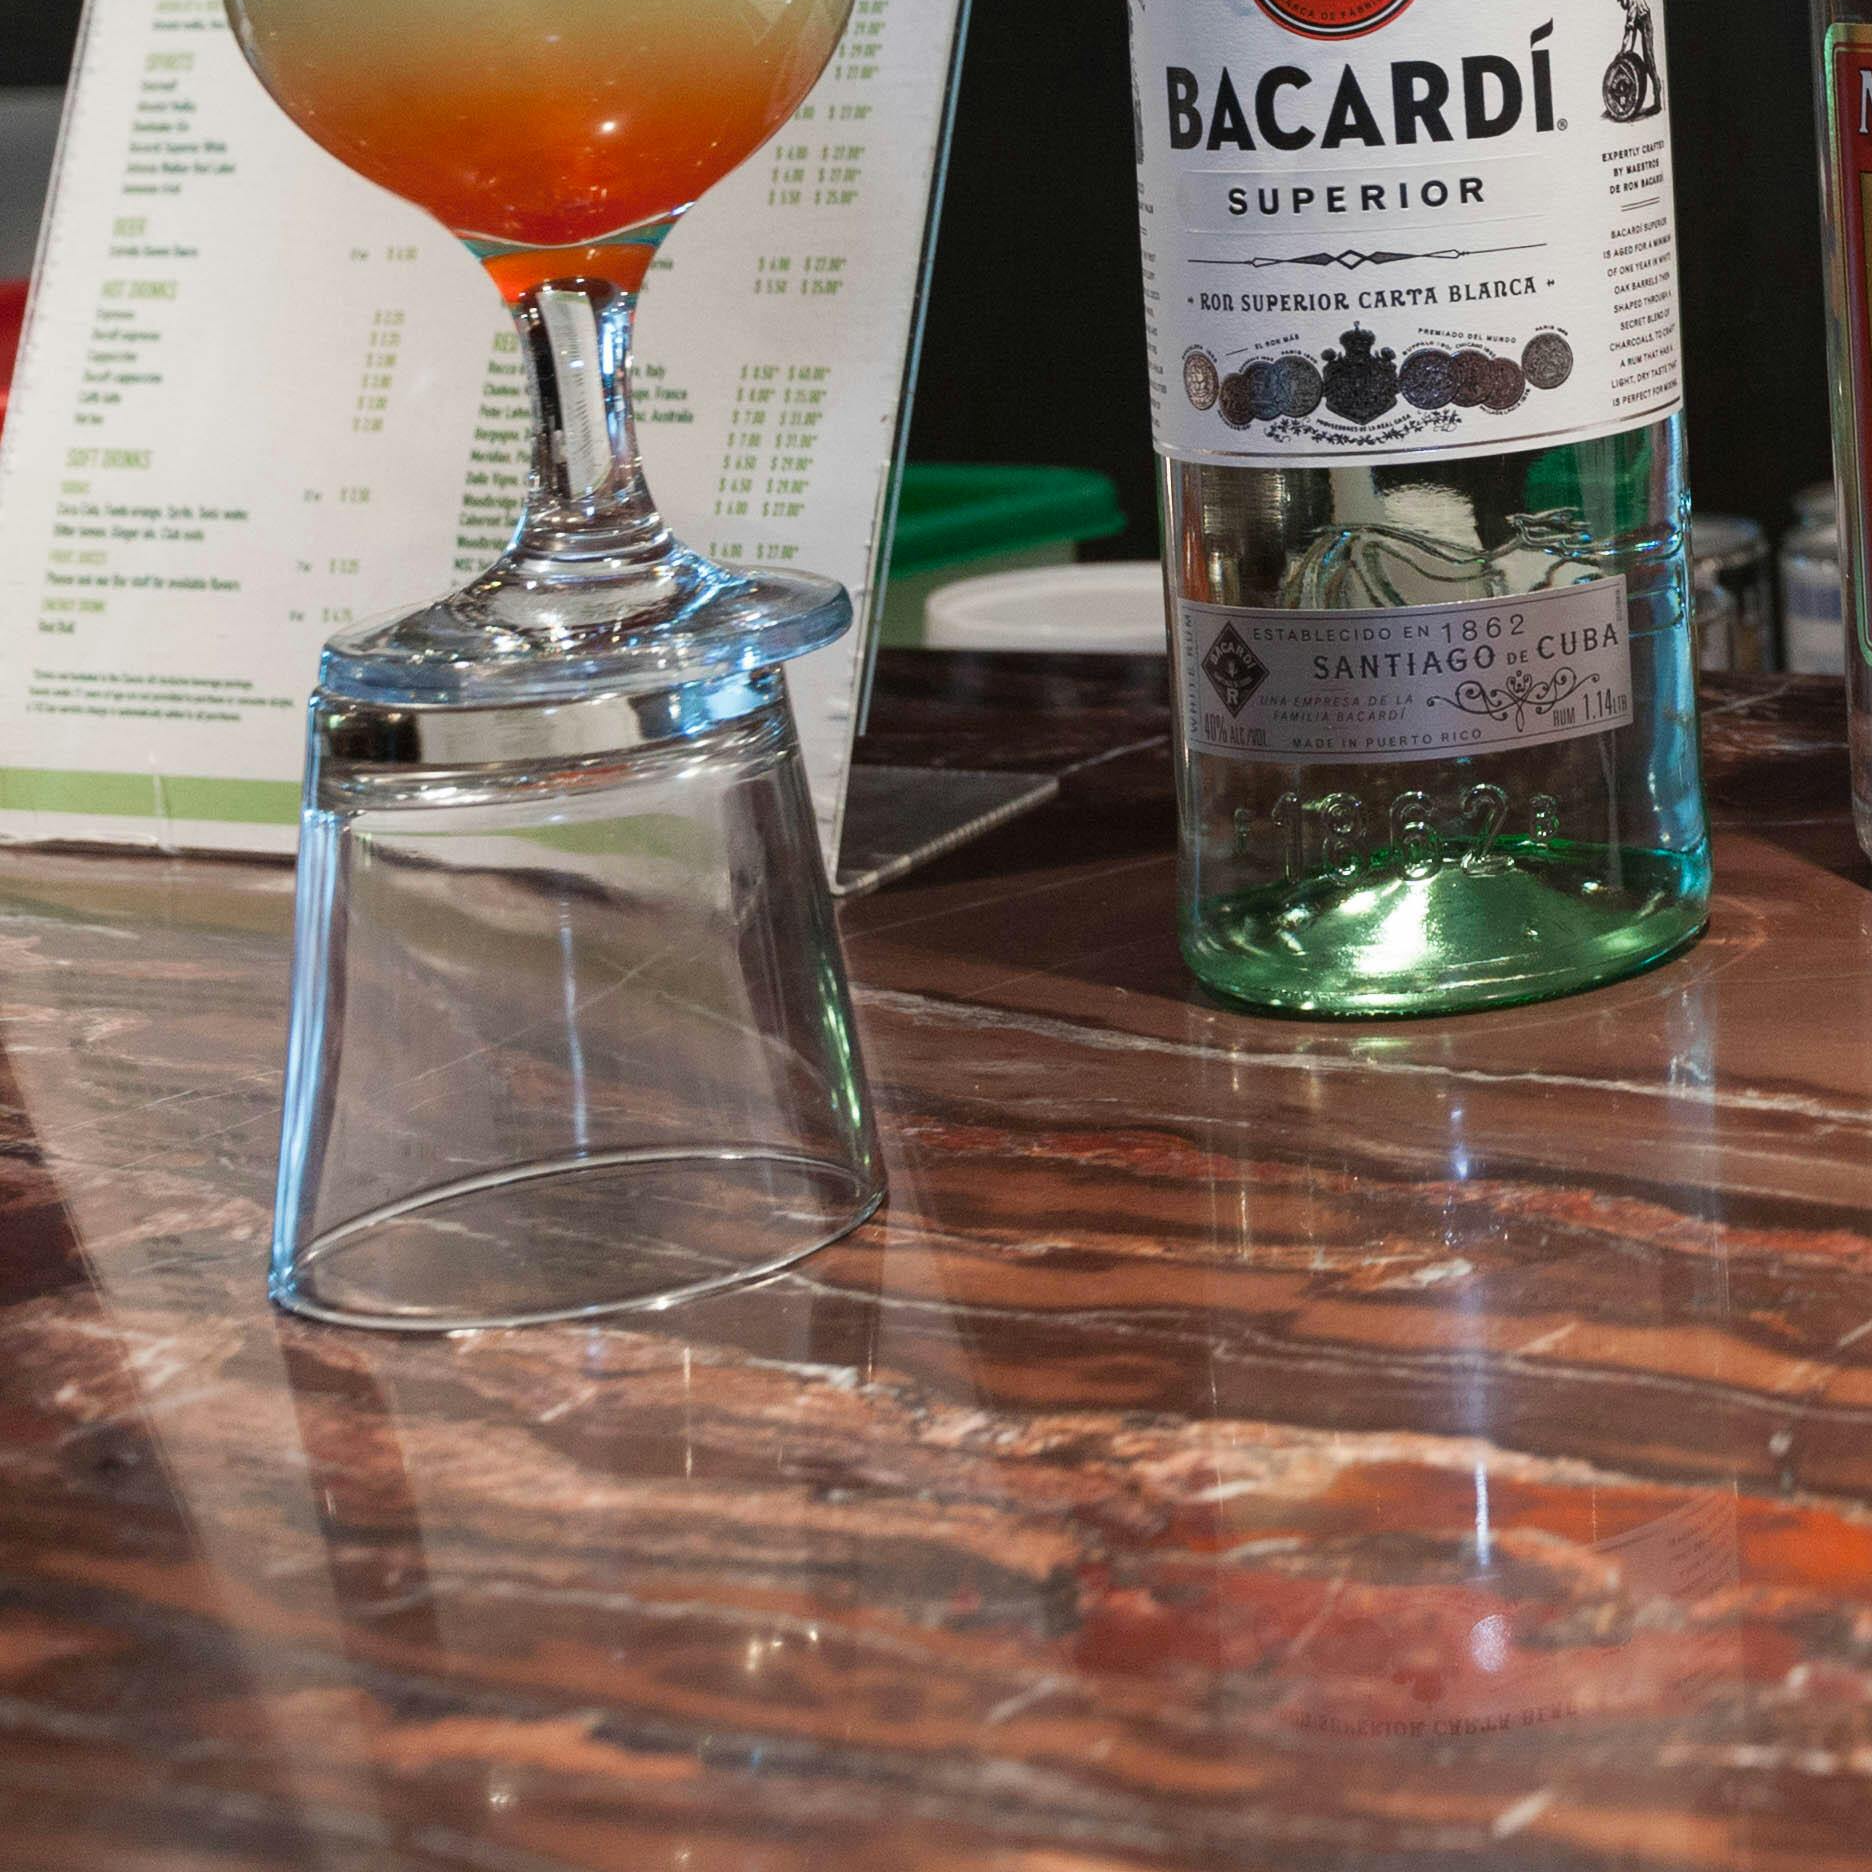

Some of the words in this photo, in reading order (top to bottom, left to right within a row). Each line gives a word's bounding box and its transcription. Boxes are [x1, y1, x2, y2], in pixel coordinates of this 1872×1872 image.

[1321, 11, 1336, 21] DE
[1166, 17, 1556, 152] BACARDÍ
[1601, 146, 1641, 163] EXPERTLY
[1613, 167, 1624, 178] BY
[1626, 158, 1660, 175] MAESTROS
[1227, 176, 1487, 216] SUPERIOR
[1609, 183, 1621, 195] DE
[1623, 180, 1639, 193] RON
[1199, 292, 1234, 312] RON
[1240, 290, 1350, 313] SUPERIOR
[1358, 285, 1439, 310] CARTA
[1448, 276, 1537, 304] BLANCA
[1417, 326, 1465, 341] PREMIADO
[1466, 332, 1484, 342] DEL
[1486, 334, 1518, 345] MUNDO
[1252, 627, 1392, 642] ESTABLECIDO
[1403, 625, 1429, 640] EN
[1441, 613, 1526, 644] 1862
[1313, 644, 1496, 680] SANTIAGO
[1506, 649, 1530, 666] DE
[1536, 622, 1619, 661] CUBA
[1259, 693, 1289, 707] UNA
[1293, 694, 1361, 708] EMPRESA
[1367, 694, 1388, 707] DE
[1396, 693, 1414, 706] LA
[1272, 709, 1331, 723] FAMILIA
[1336, 705, 1408, 723] BACARDÍ
[1552, 708, 1576, 727] RUM
[1292, 736, 1334, 750] MADE
[1342, 736, 1358, 749] IN
[1366, 733, 1433, 749] PUERTO
[1441, 729, 1482, 744] RICO
